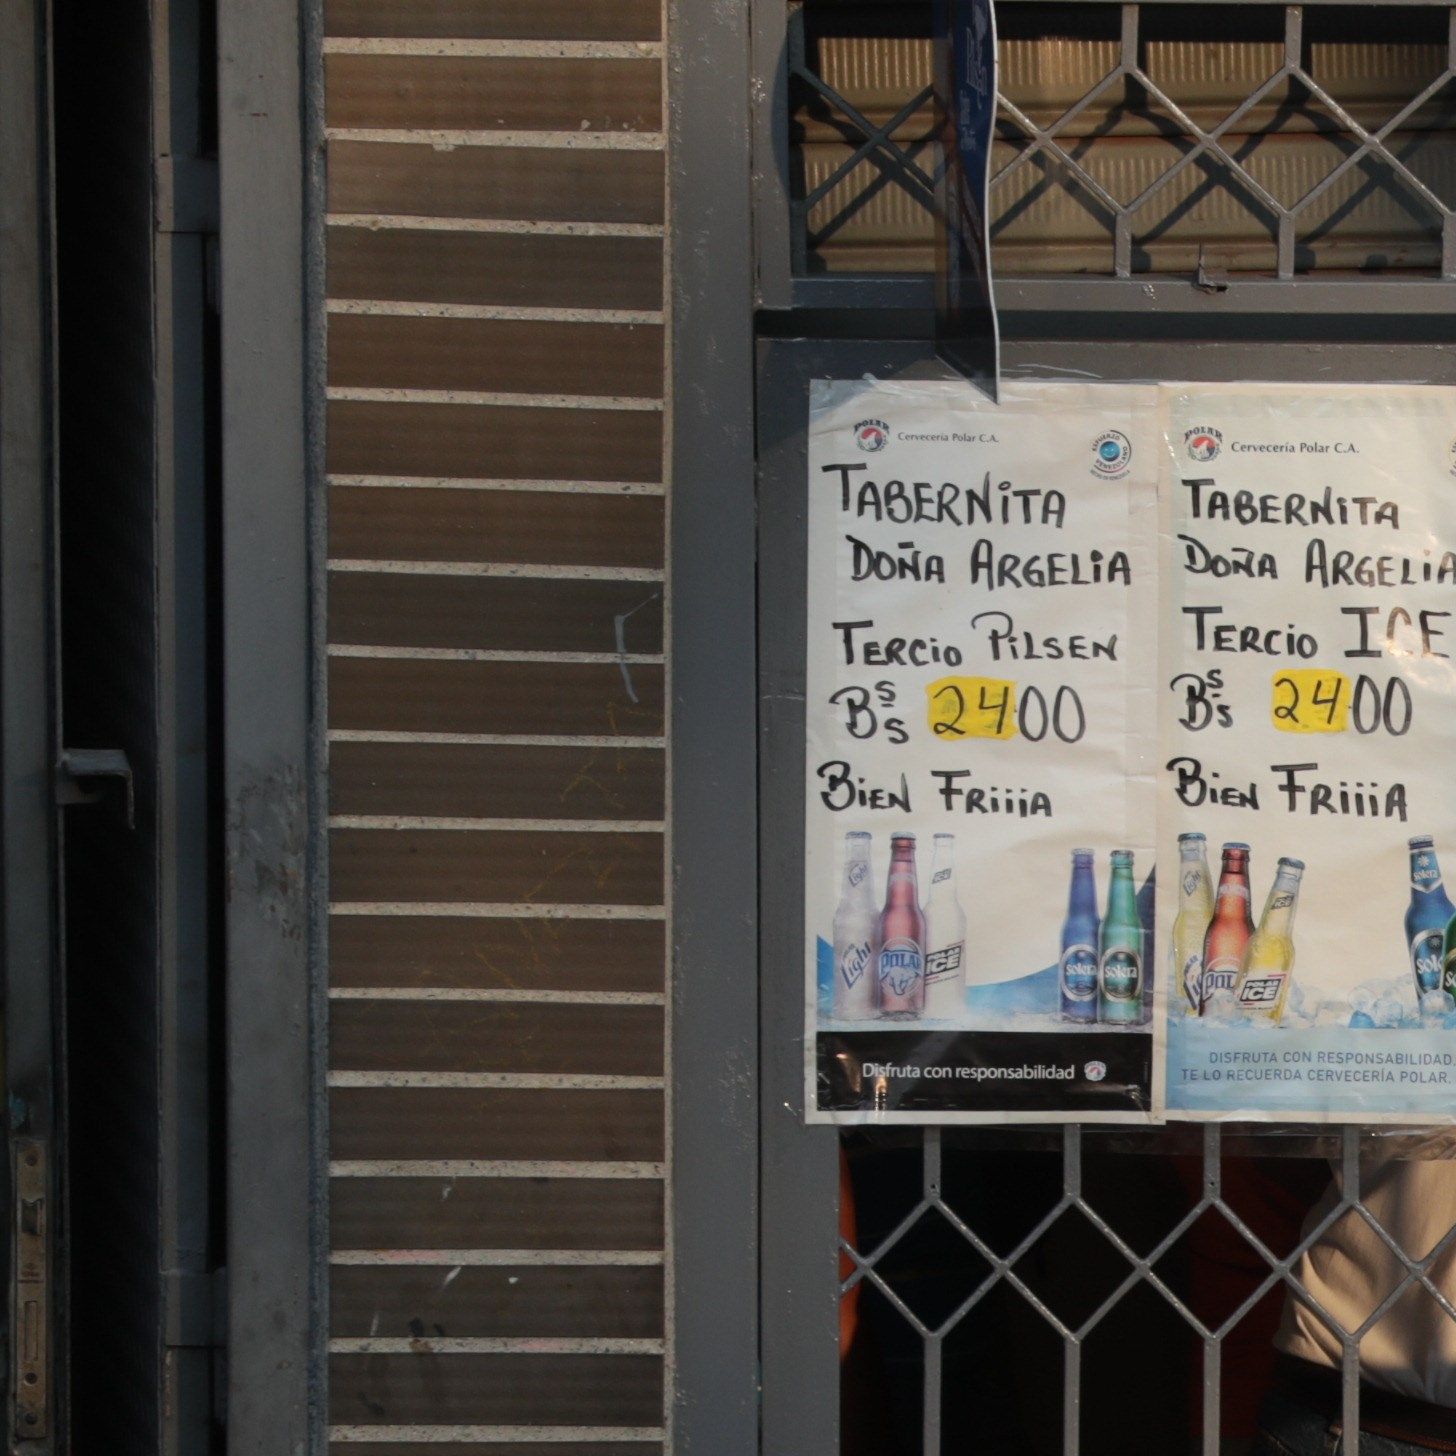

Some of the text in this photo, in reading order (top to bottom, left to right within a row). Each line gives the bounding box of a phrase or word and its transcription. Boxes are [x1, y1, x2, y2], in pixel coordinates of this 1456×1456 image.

[952, 432, 976, 443] Polar
[1231, 441, 1361, 454] Cervecería Polar C.A.
[845, 534, 945, 584] DOÑA
[1177, 534, 1278, 579] DOÑA
[1341, 606, 1452, 658] ICE
[1241, 987, 1277, 1000] ICE
[1209, 1052, 1278, 1064] DISFRUTA
[1282, 1052, 1312, 1064] CON
[862, 1062, 1075, 1082] Disfruta con responsabilidad
[1181, 1068, 1199, 1081] TE
[1202, 1069, 1222, 1081] LO
[1226, 1069, 1302, 1081] RECUERDA
[1307, 1067, 1395, 1083] CERVECERÍA
